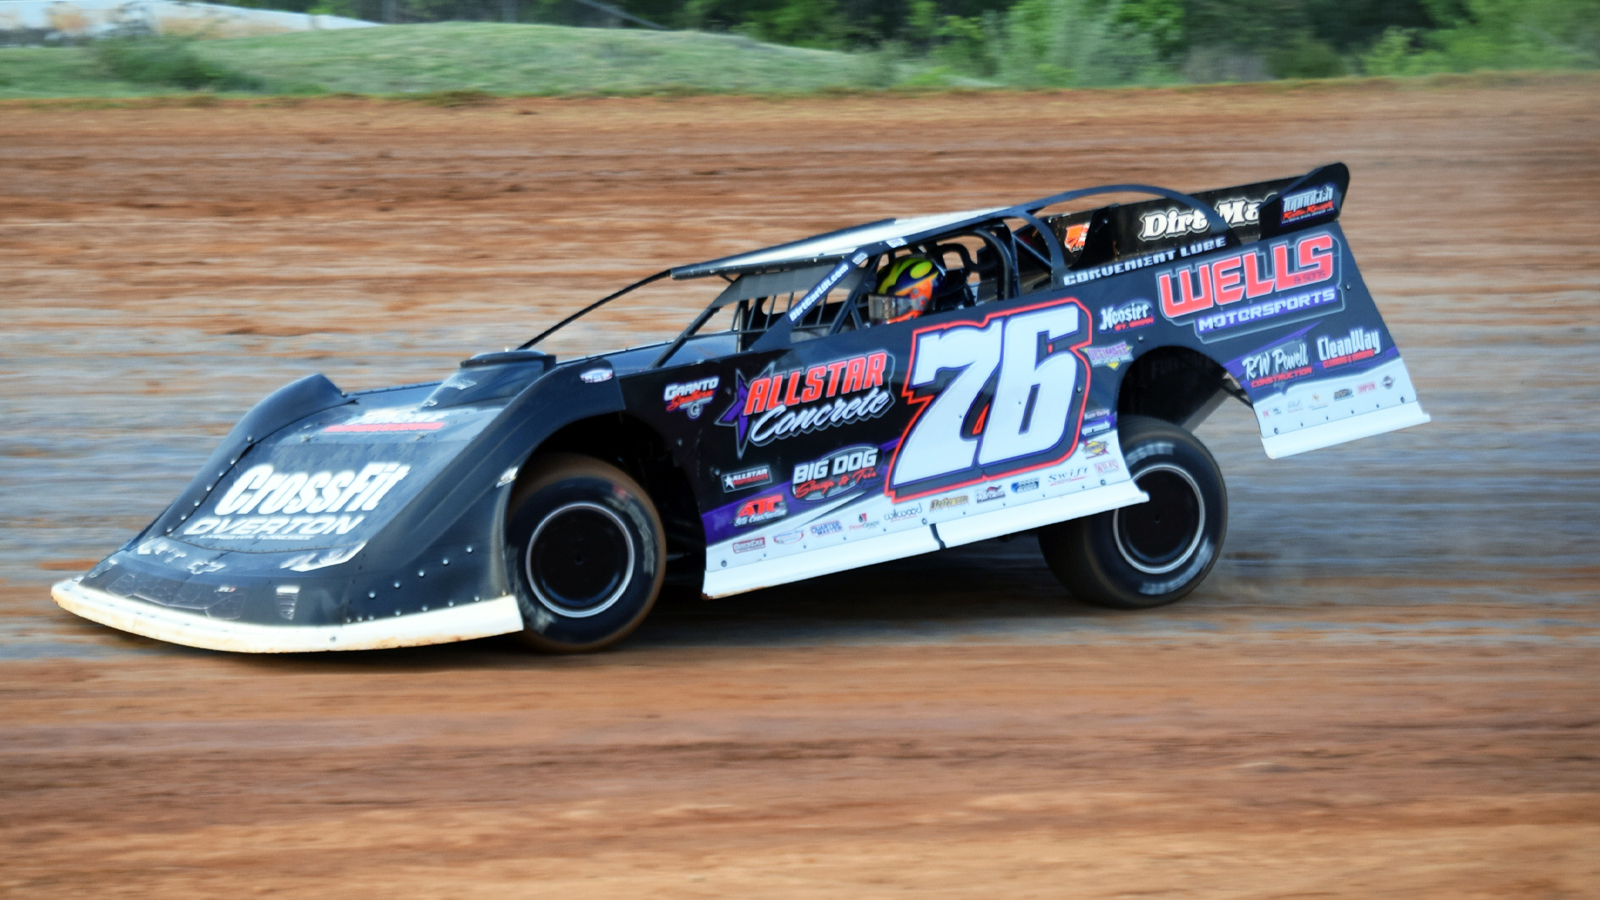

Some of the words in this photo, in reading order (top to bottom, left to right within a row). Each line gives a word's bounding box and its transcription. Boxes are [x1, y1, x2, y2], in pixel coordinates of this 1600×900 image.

[1142, 208, 1208, 238] Dirt
[1219, 199, 1259, 224] Ma
[1063, 250, 1176, 286] CONVENIENT
[1180, 237, 1226, 258] LUBE
[1158, 234, 1333, 318] WELLS
[1098, 303, 1149, 330] Hoosier
[1198, 287, 1336, 332] MOTORSPORTS
[1271, 342, 1309, 373] Powell
[1316, 328, 1381, 362] CleanWay
[743, 352, 887, 416] ALLSTAR
[890, 302, 1080, 488] 76
[1250, 366, 1313, 388] CONSTRUCTION
[750, 387, 890, 442] Concrete
[732, 468, 768, 481] ALLSTAR
[793, 460, 829, 484] BIG
[832, 448, 878, 475] DOG
[214, 461, 411, 516] CrossFit
[738, 494, 783, 517] ATC
[184, 515, 365, 535] OVERTON
